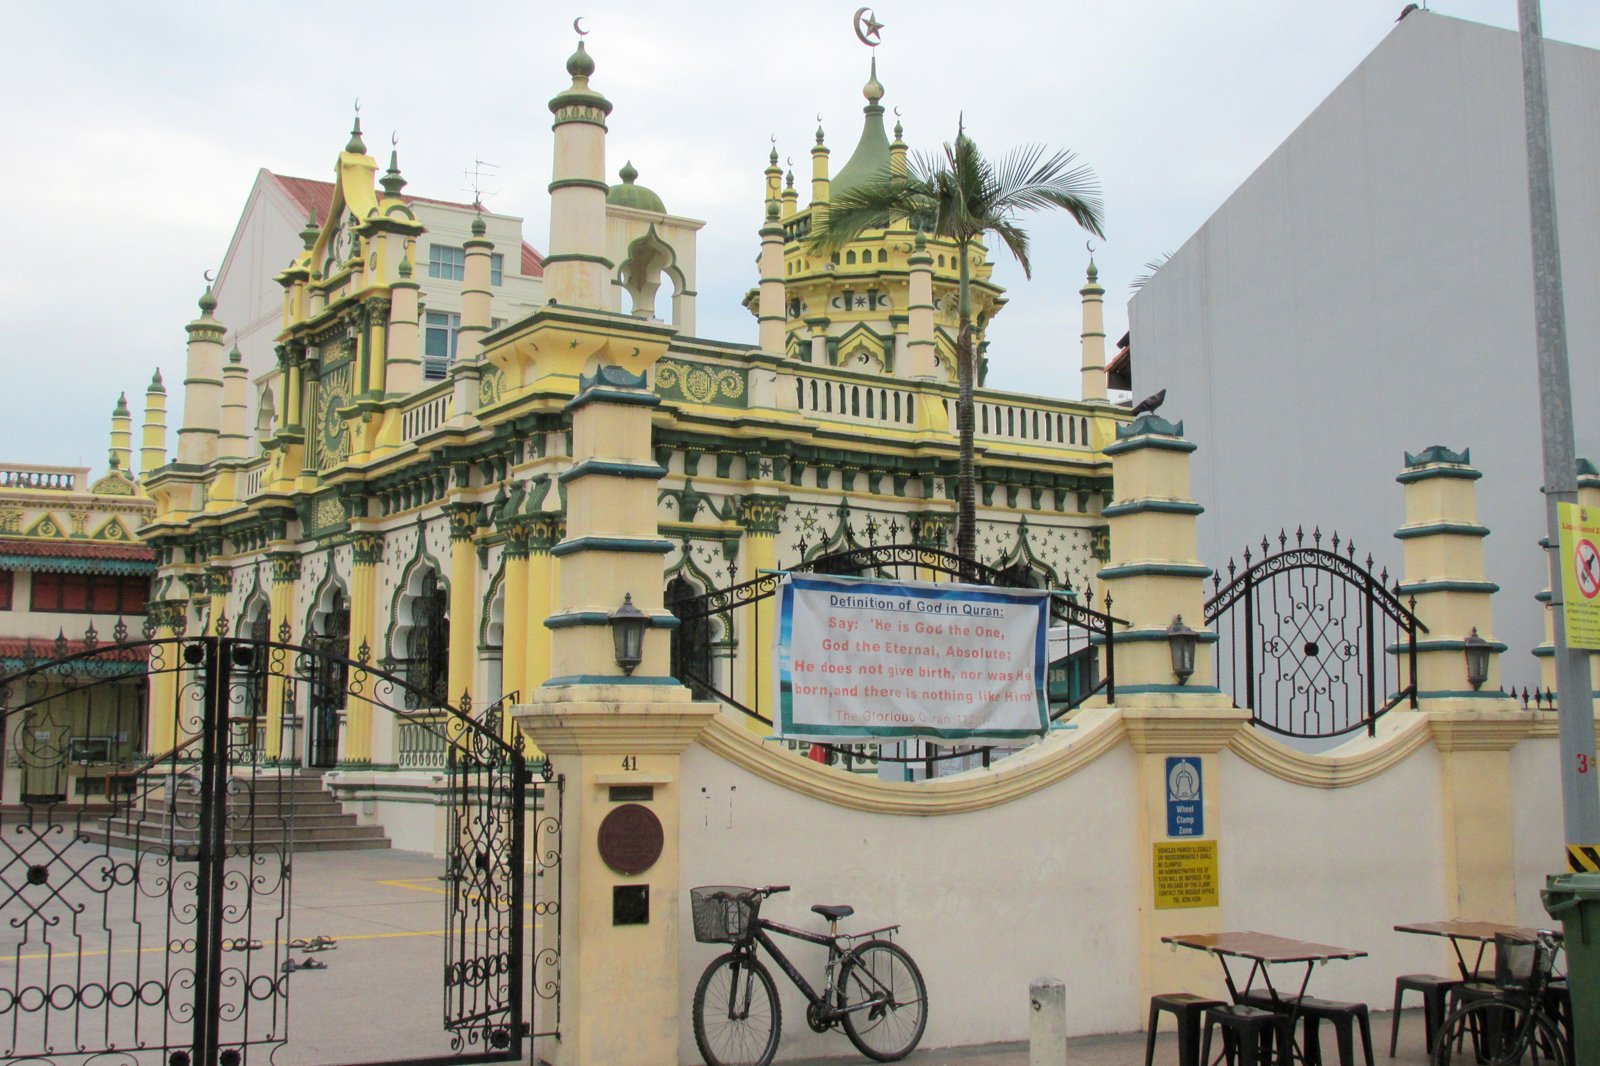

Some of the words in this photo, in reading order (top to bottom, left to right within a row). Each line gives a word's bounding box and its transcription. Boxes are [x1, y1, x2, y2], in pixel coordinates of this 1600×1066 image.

[830, 595, 894, 610] Definition
[899, 600, 911, 611] of
[917, 601, 942, 613] God
[946, 603, 958, 614] in
[963, 604, 1004, 617] Quran:
[828, 617, 858, 632] Say:
[898, 621, 910, 633] is
[915, 622, 943, 634] God
[948, 624, 970, 636] the
[975, 626, 1005, 640] One,
[822, 639, 849, 651] God
[856, 641, 880, 652] the
[885, 642, 940, 658] Eternal,
[946, 646, 1011, 661] Absolute;
[794, 660, 815, 672] He
[821, 662, 852, 674] does
[859, 663, 883, 675] not
[888, 664, 914, 678] give
[919, 666, 955, 680] birth,
[960, 670, 982, 680] nor
[988, 671, 1013, 681] was
[1015, 670, 1032, 681] He
[864, 685, 902, 698] there
[906, 687, 917, 699] is
[922, 690, 974, 704] nothing
[980, 691, 1000, 702] like
[836, 710, 858, 721] The
[863, 710, 915, 722] Glorious
[621, 755, 638, 771] 41
[1574, 753, 1588, 774] 3
[1176, 805, 1194, 813] Wheel
[1176, 816, 1195, 825] Clamp
[1178, 826, 1193, 834] Zone
